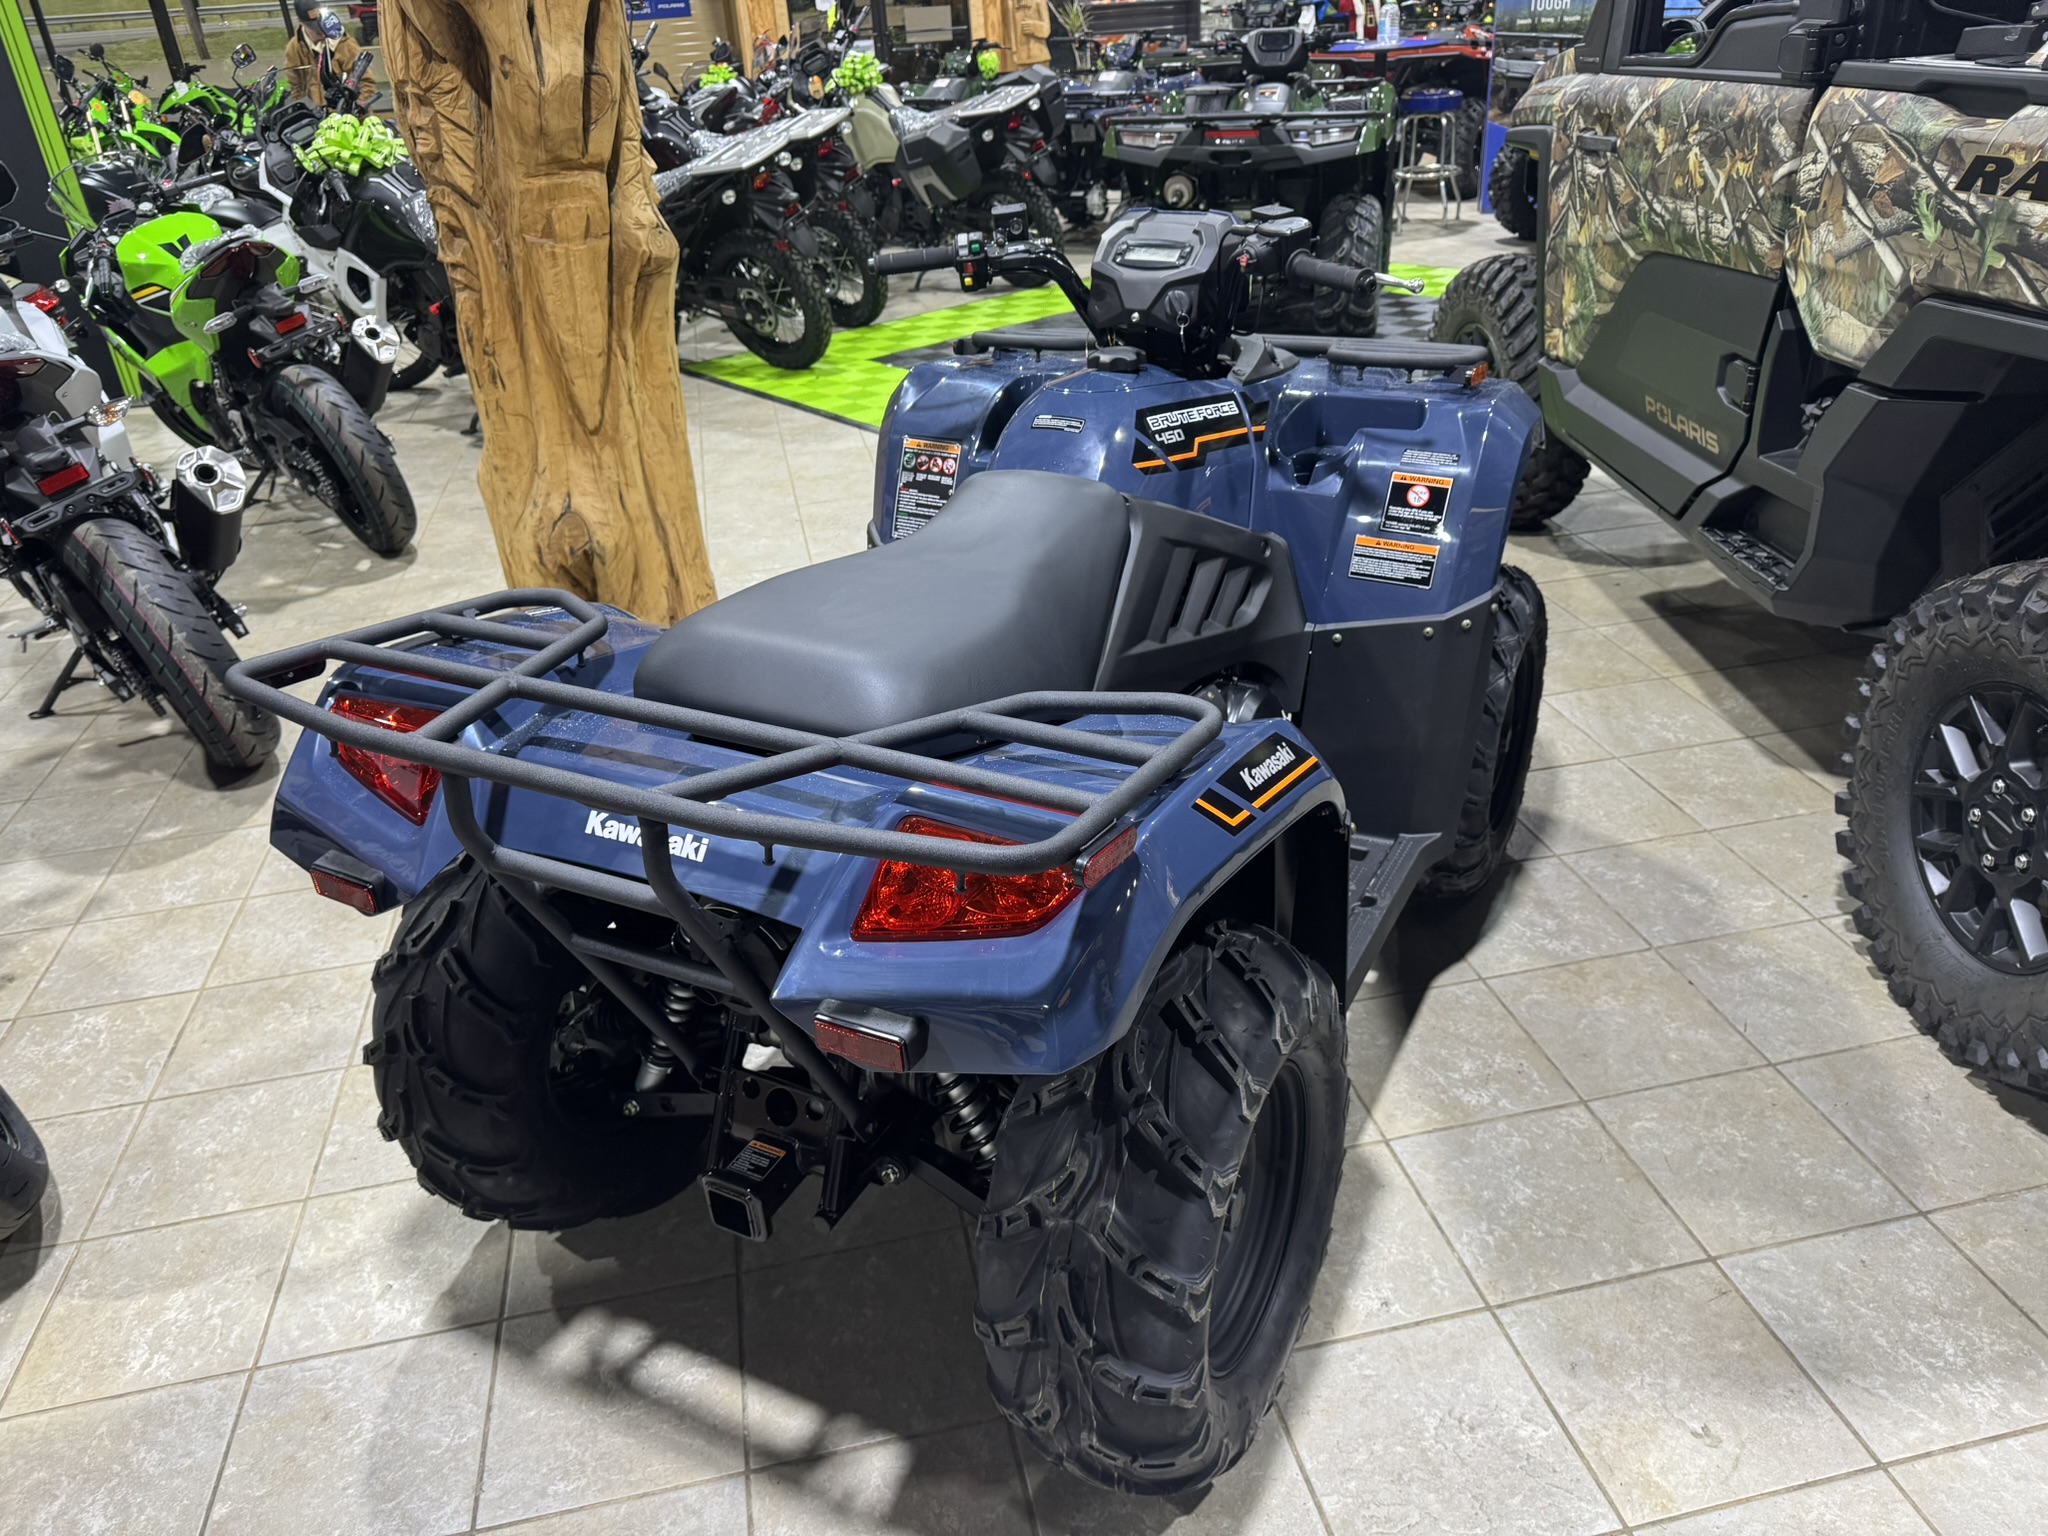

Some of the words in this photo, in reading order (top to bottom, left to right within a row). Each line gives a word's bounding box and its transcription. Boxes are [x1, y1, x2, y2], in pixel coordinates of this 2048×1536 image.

[1530, 0, 1571, 11] TOUGH
[1645, 394, 1720, 455] POLARIS
[1155, 428, 1186, 445] 450
[1409, 475, 1445, 486] WARNING
[1383, 541, 1415, 551] WARNING
[1239, 741, 1297, 791] Kawasaki
[584, 809, 710, 863] Kawaki
